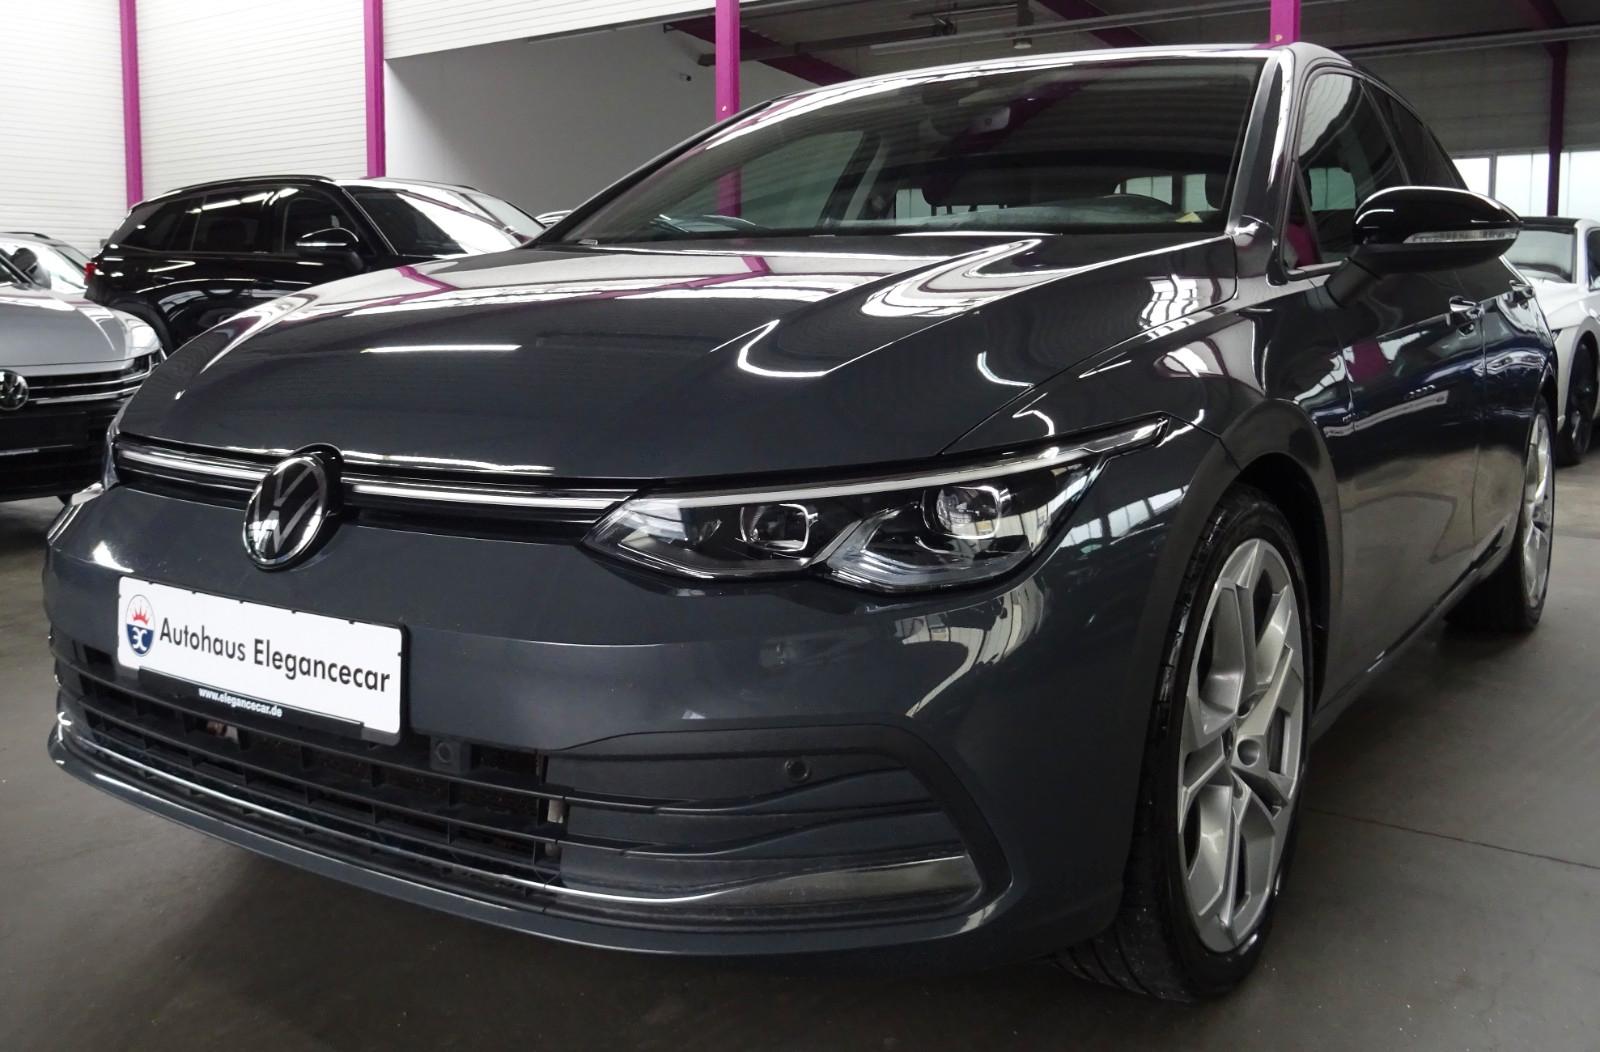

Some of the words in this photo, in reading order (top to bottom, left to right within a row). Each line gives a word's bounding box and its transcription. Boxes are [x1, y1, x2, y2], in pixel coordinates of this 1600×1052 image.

[159, 617, 246, 662] Autohaus
[253, 638, 391, 693] Elegancecar
[198, 687, 283, 718] www.elegancecar.de
